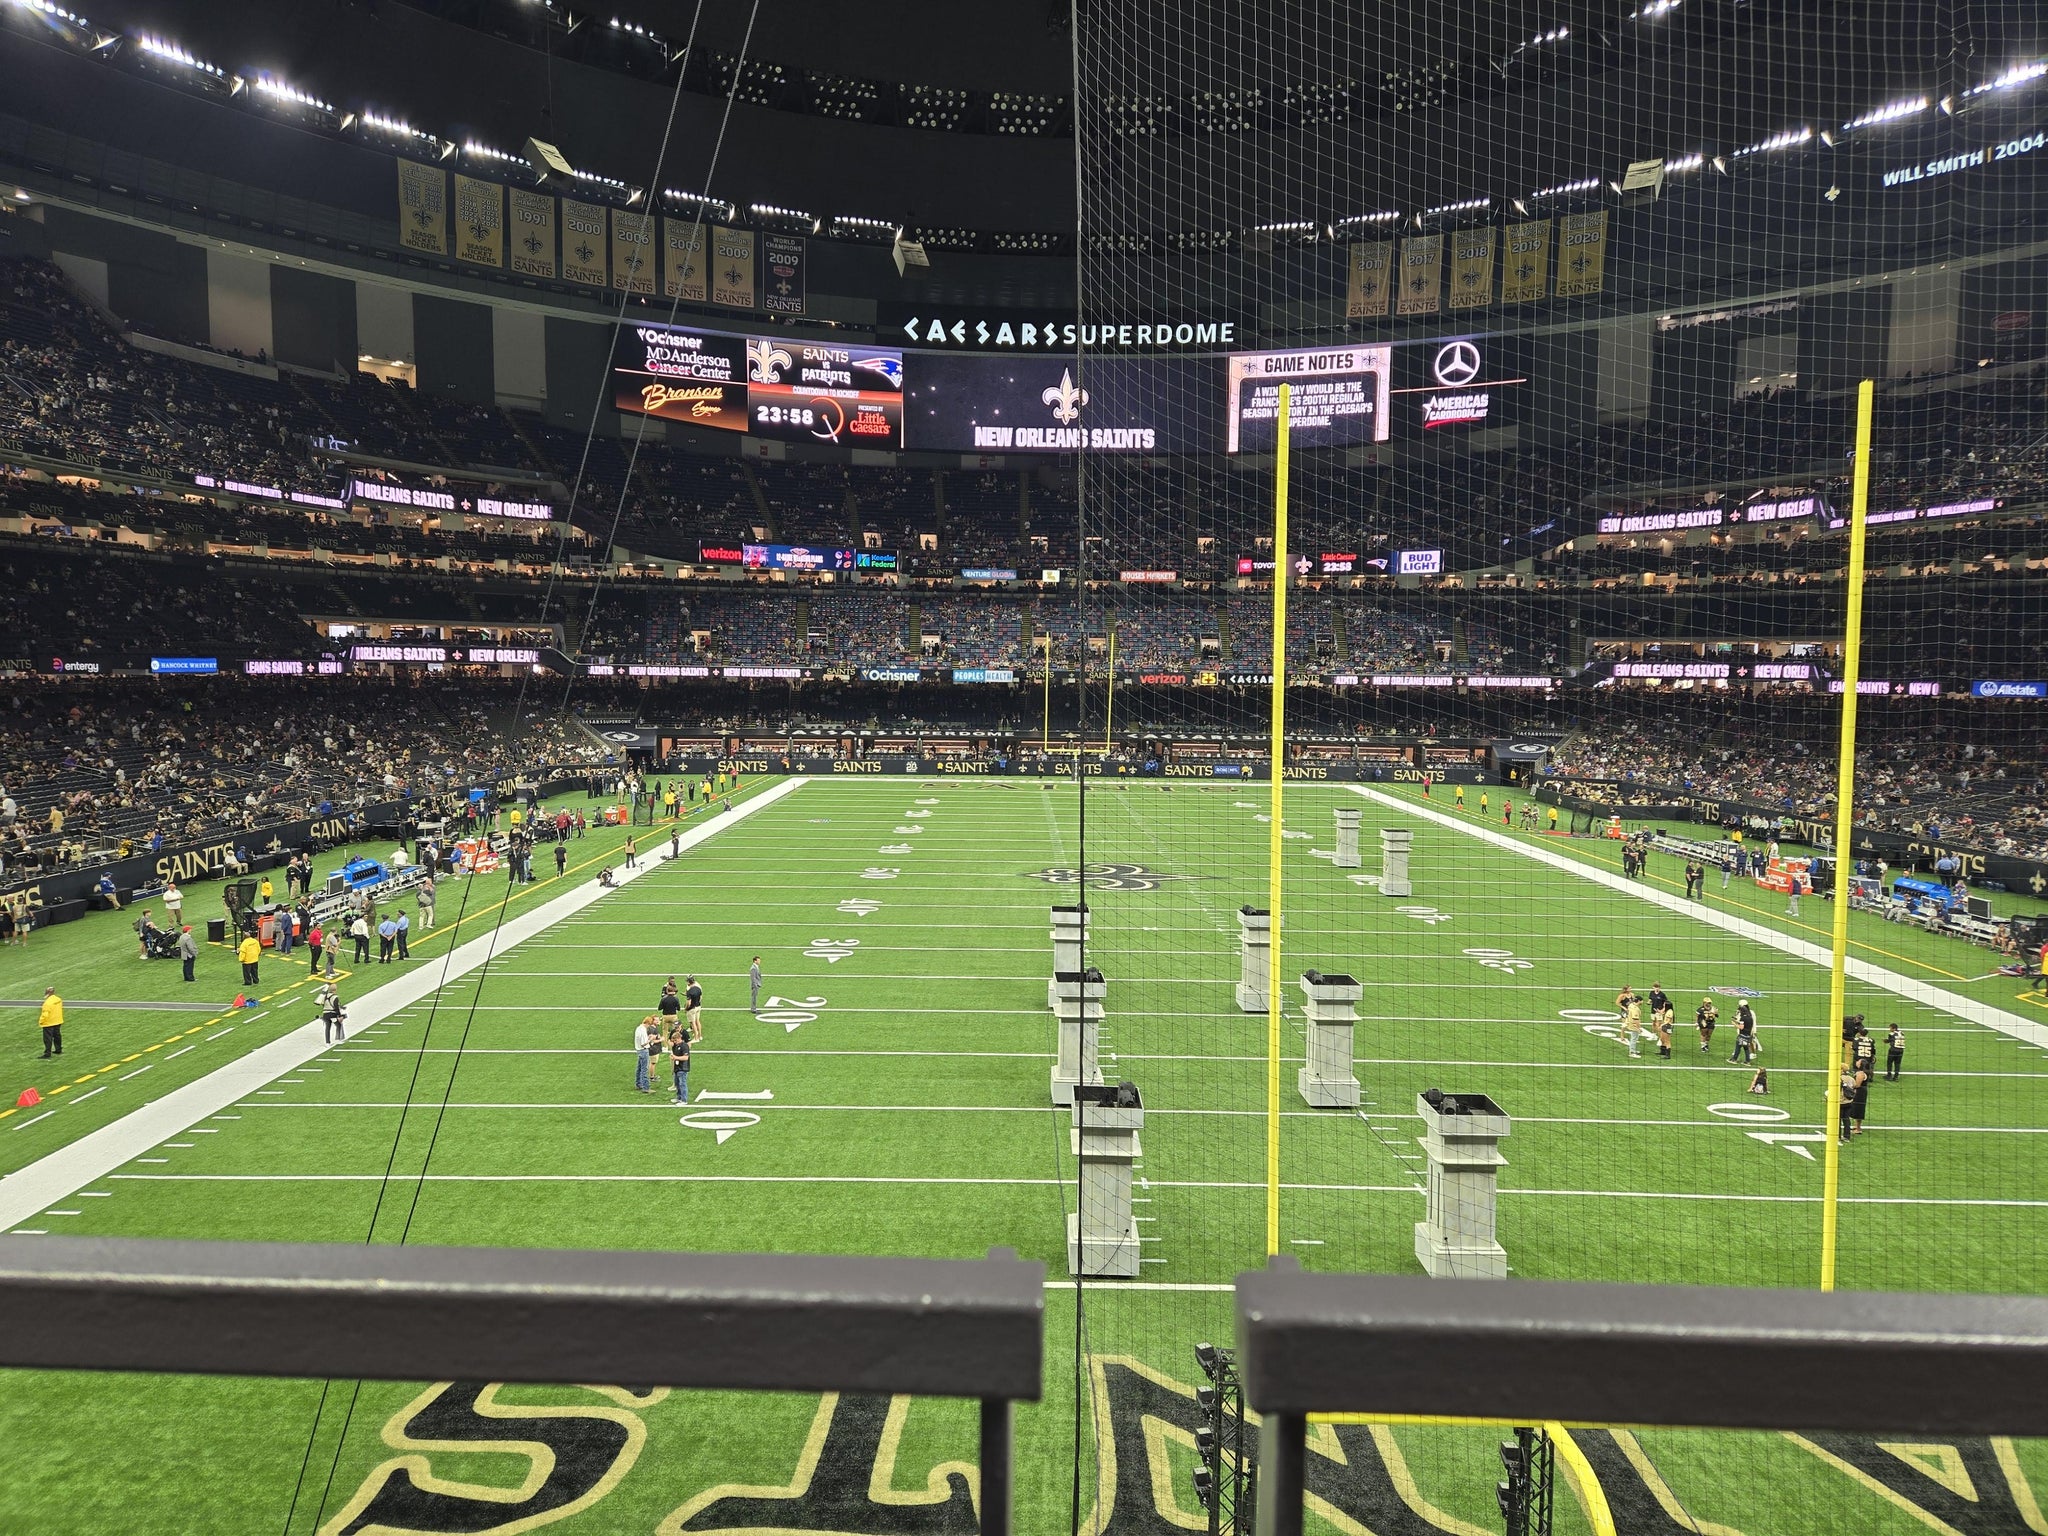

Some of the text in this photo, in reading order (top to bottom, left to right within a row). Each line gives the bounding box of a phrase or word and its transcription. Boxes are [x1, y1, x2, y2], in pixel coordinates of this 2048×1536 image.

[1883, 150, 1984, 187] WILL SMITH
[518, 209, 546, 226] 1991
[568, 219, 601, 235] 2000
[618, 229, 650, 245] 2006
[773, 237, 795, 245] WORLD
[1566, 231, 1600, 246] 2020
[670, 237, 701, 252] 2009
[765, 241, 802, 252] CHAMPIONS
[1512, 241, 1542, 253] 2019
[719, 245, 748, 259] 2009
[1459, 246, 1488, 259] 2018
[769, 252, 799, 266] 2009
[1408, 254, 1435, 266] 2017
[514, 261, 553, 277] SAINTS
[565, 268, 604, 285] SAINTS
[1505, 288, 1543, 300] SAINTS
[1560, 281, 1600, 295] SAINTS
[716, 292, 752, 305] SAINTS
[1451, 295, 1490, 307] SAINTS
[766, 299, 802, 312] SAINTS
[1350, 305, 1386, 316] SAINTS
[1400, 301, 1437, 313] SAINTS
[904, 317, 1235, 346] CAESARS SUPERDOME
[645, 329, 703, 349] Ochsner
[803, 347, 849, 363] SAINTS
[1265, 353, 1354, 373] GAME NOTES
[691, 365, 732, 380] Center
[801, 368, 851, 385] PATRIOTS
[792, 385, 860, 398] COUNTDOWN TO KICKOFF
[1255, 381, 1361, 397] A WIN WOULD BE THE
[641, 384, 723, 411] Branson
[1302, 392, 1364, 406] 200TH REGULAR
[757, 405, 814, 425] 23:58
[1242, 402, 1373, 419] SEASON IN THE CAESAR'S
[857, 411, 885, 424] Little
[850, 420, 890, 435] Caesars
[974, 426, 1155, 449] NEW ORLEANS SAINTS
[66, 451, 100, 467] SAINTS
[140, 465, 173, 480] SAINTS
[364, 483, 412, 504] ORLEANS
[412, 489, 454, 510] SAINTS
[477, 498, 503, 515] NEW
[103, 512, 136, 525] SAINTS
[1622, 504, 1777, 532] ORLEANS SAINTS NEW
[174, 521, 205, 534] SAINTS
[239, 529, 269, 541] SAINTS
[307, 536, 339, 548] SAINTS
[375, 542, 407, 552] SAINTS
[446, 548, 478, 558] SAINTS
[514, 552, 546, 562] SAINTS
[702, 546, 742, 560] verizon
[871, 554, 896, 562] Keesler
[1408, 553, 1433, 562] BUD
[927, 568, 953, 577] SAINTS
[1323, 562, 1353, 572] 23:58
[1403, 562, 1438, 571] LIGHT
[962, 570, 1017, 580] VENTURE GLOBAL
[1121, 571, 1176, 581] ROUSES MARKETS
[403, 647, 446, 662] SAINTS
[469, 649, 494, 663] NEW
[64, 661, 99, 673] entergy
[271, 661, 337, 675] SAINTS NEW
[629, 665, 801, 678] NEW ORLEANS SAINTS NEW ORLEANS SAINTS
[826, 668, 855, 676] SAINTS
[1631, 664, 1683, 677] ORLEANS
[1684, 664, 1730, 678] SAINTS
[1755, 664, 1782, 678] NEW
[869, 669, 921, 682] Ochsner
[954, 672, 1013, 681] PEOPLES HEALTH
[1026, 671, 1055, 679] SAINTS
[1089, 672, 1117, 680] SAINTS
[1140, 674, 1186, 684] verizon
[1201, 673, 1217, 683] 25
[1291, 674, 1320, 682] SAINTS
[1373, 676, 1552, 687] NEW ORLEANS SAINTS NEW ORLEANS SAINTS
[1909, 682, 1932, 695] NEW
[1997, 684, 2038, 696] Allstate
[890, 730, 1015, 738] SUPERDOME
[718, 760, 768, 772] SAINTS
[833, 761, 882, 773] SAINTS
[1165, 765, 1213, 777] SAINTS
[1394, 769, 1445, 782] SAINTS
[156, 842, 235, 882] SAINTS
[802, 938, 861, 958] 30
[1461, 947, 1534, 971] 30
[755, 994, 828, 1025] 20
[1857, 1045, 1872, 1057] 25
[679, 1088, 775, 1131] 10
